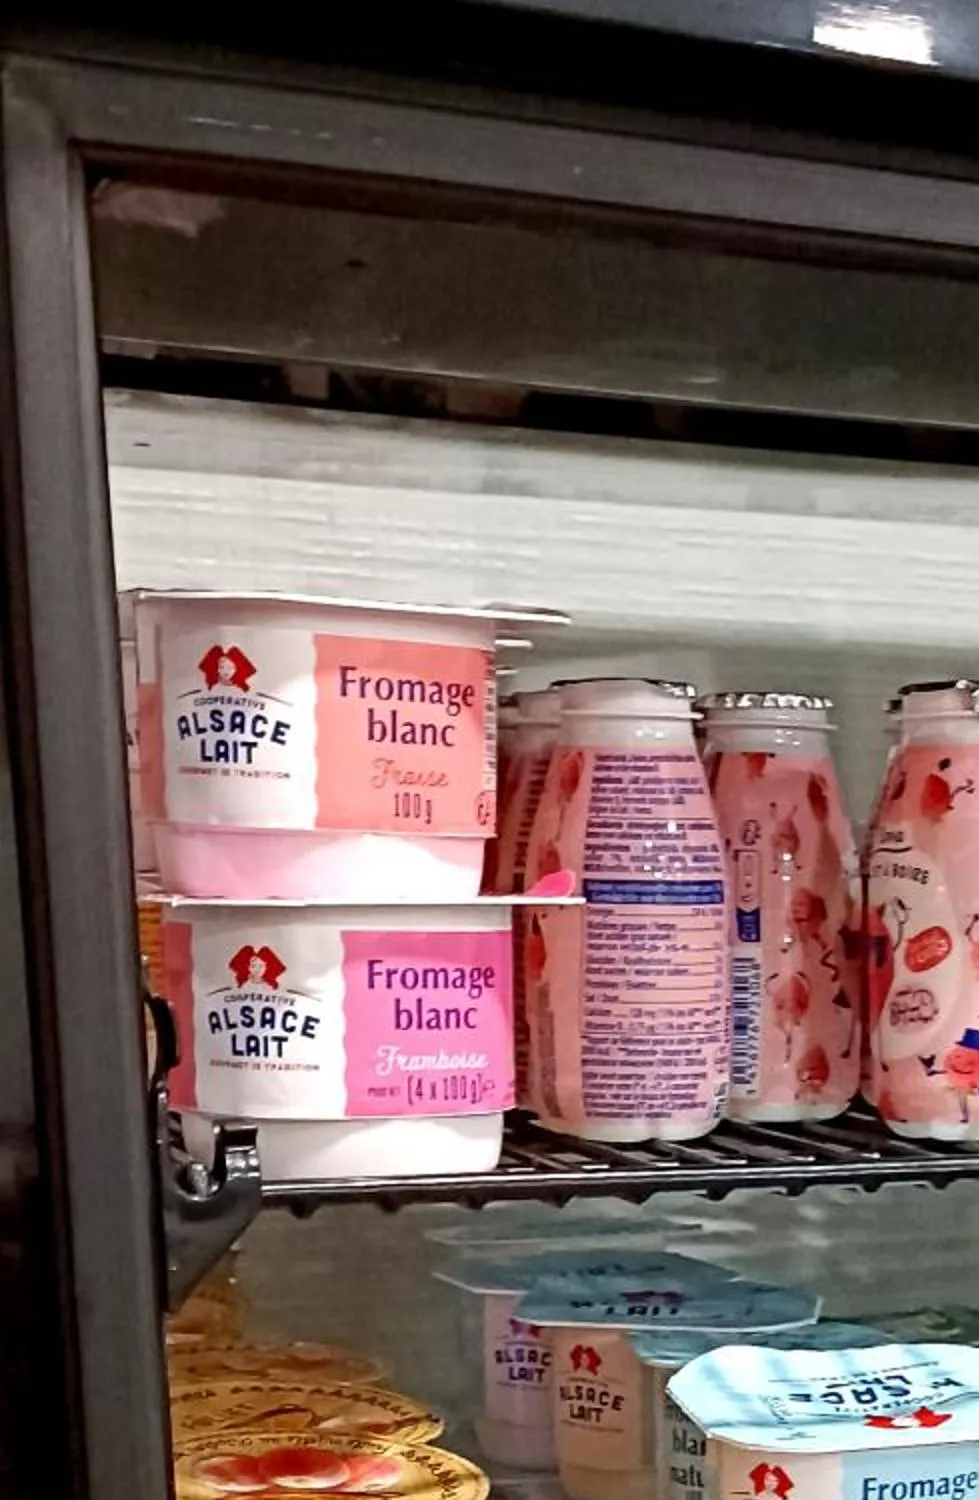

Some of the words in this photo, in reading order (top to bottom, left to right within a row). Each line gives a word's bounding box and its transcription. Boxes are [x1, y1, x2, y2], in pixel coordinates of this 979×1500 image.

[339, 665, 476, 717] Fromage
[177, 709, 291, 746] ALSACE
[367, 708, 455, 747] blanc
[200, 738, 259, 764] LAIT
[367, 959, 496, 1000] Fromage
[208, 1005, 321, 1040] ALSACE
[394, 997, 478, 1031] blanc
[231, 1033, 289, 1059] LAIT
[375, 1043, 490, 1077] Framboise
[495, 1347, 553, 1367] ALSAC
